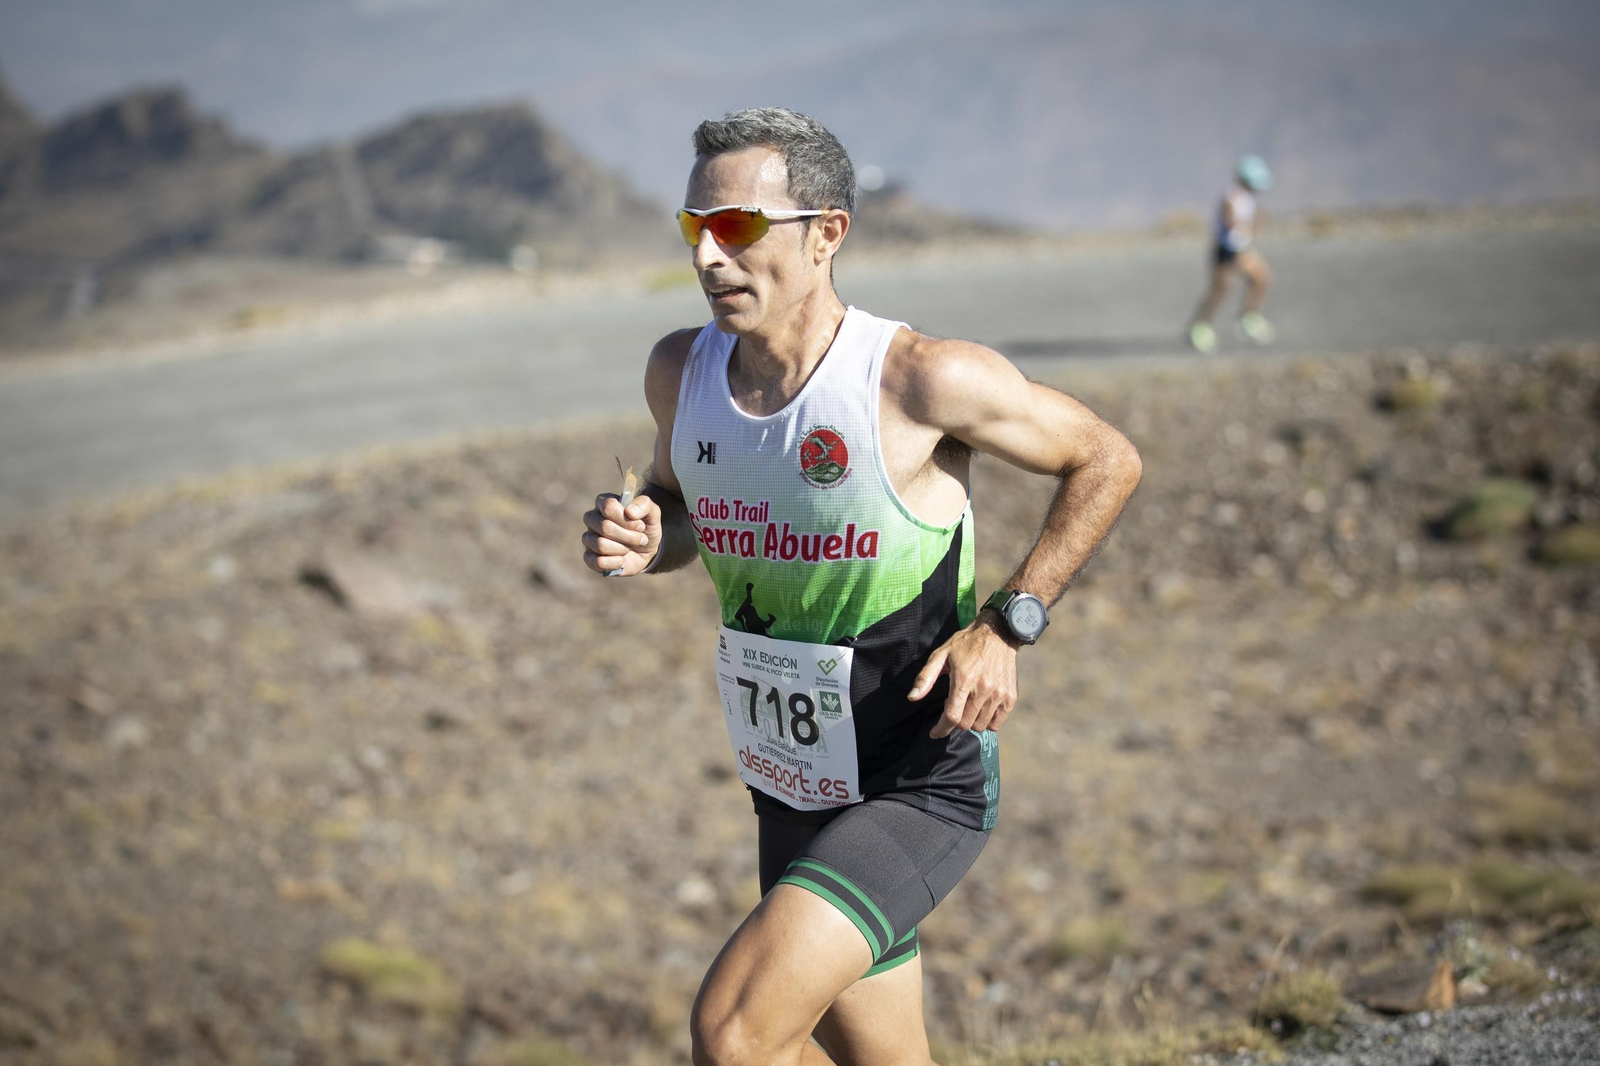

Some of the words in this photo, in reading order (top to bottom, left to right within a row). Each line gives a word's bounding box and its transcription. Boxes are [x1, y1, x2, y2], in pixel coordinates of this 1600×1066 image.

[697, 497, 729, 521] Club
[733, 499, 769, 523] Trail
[764, 522, 879, 562] Abuela
[742, 648, 758, 662] XIX
[760, 651, 798, 670] EDICIÓN
[783, 671, 801, 679] VELETA
[815, 676, 839, 684] Diputación
[736, 676, 819, 746] 718
[758, 743, 786, 763] GUTIERREZ
[786, 756, 813, 770] MARTIN
[799, 795, 817, 804] TRAIL
